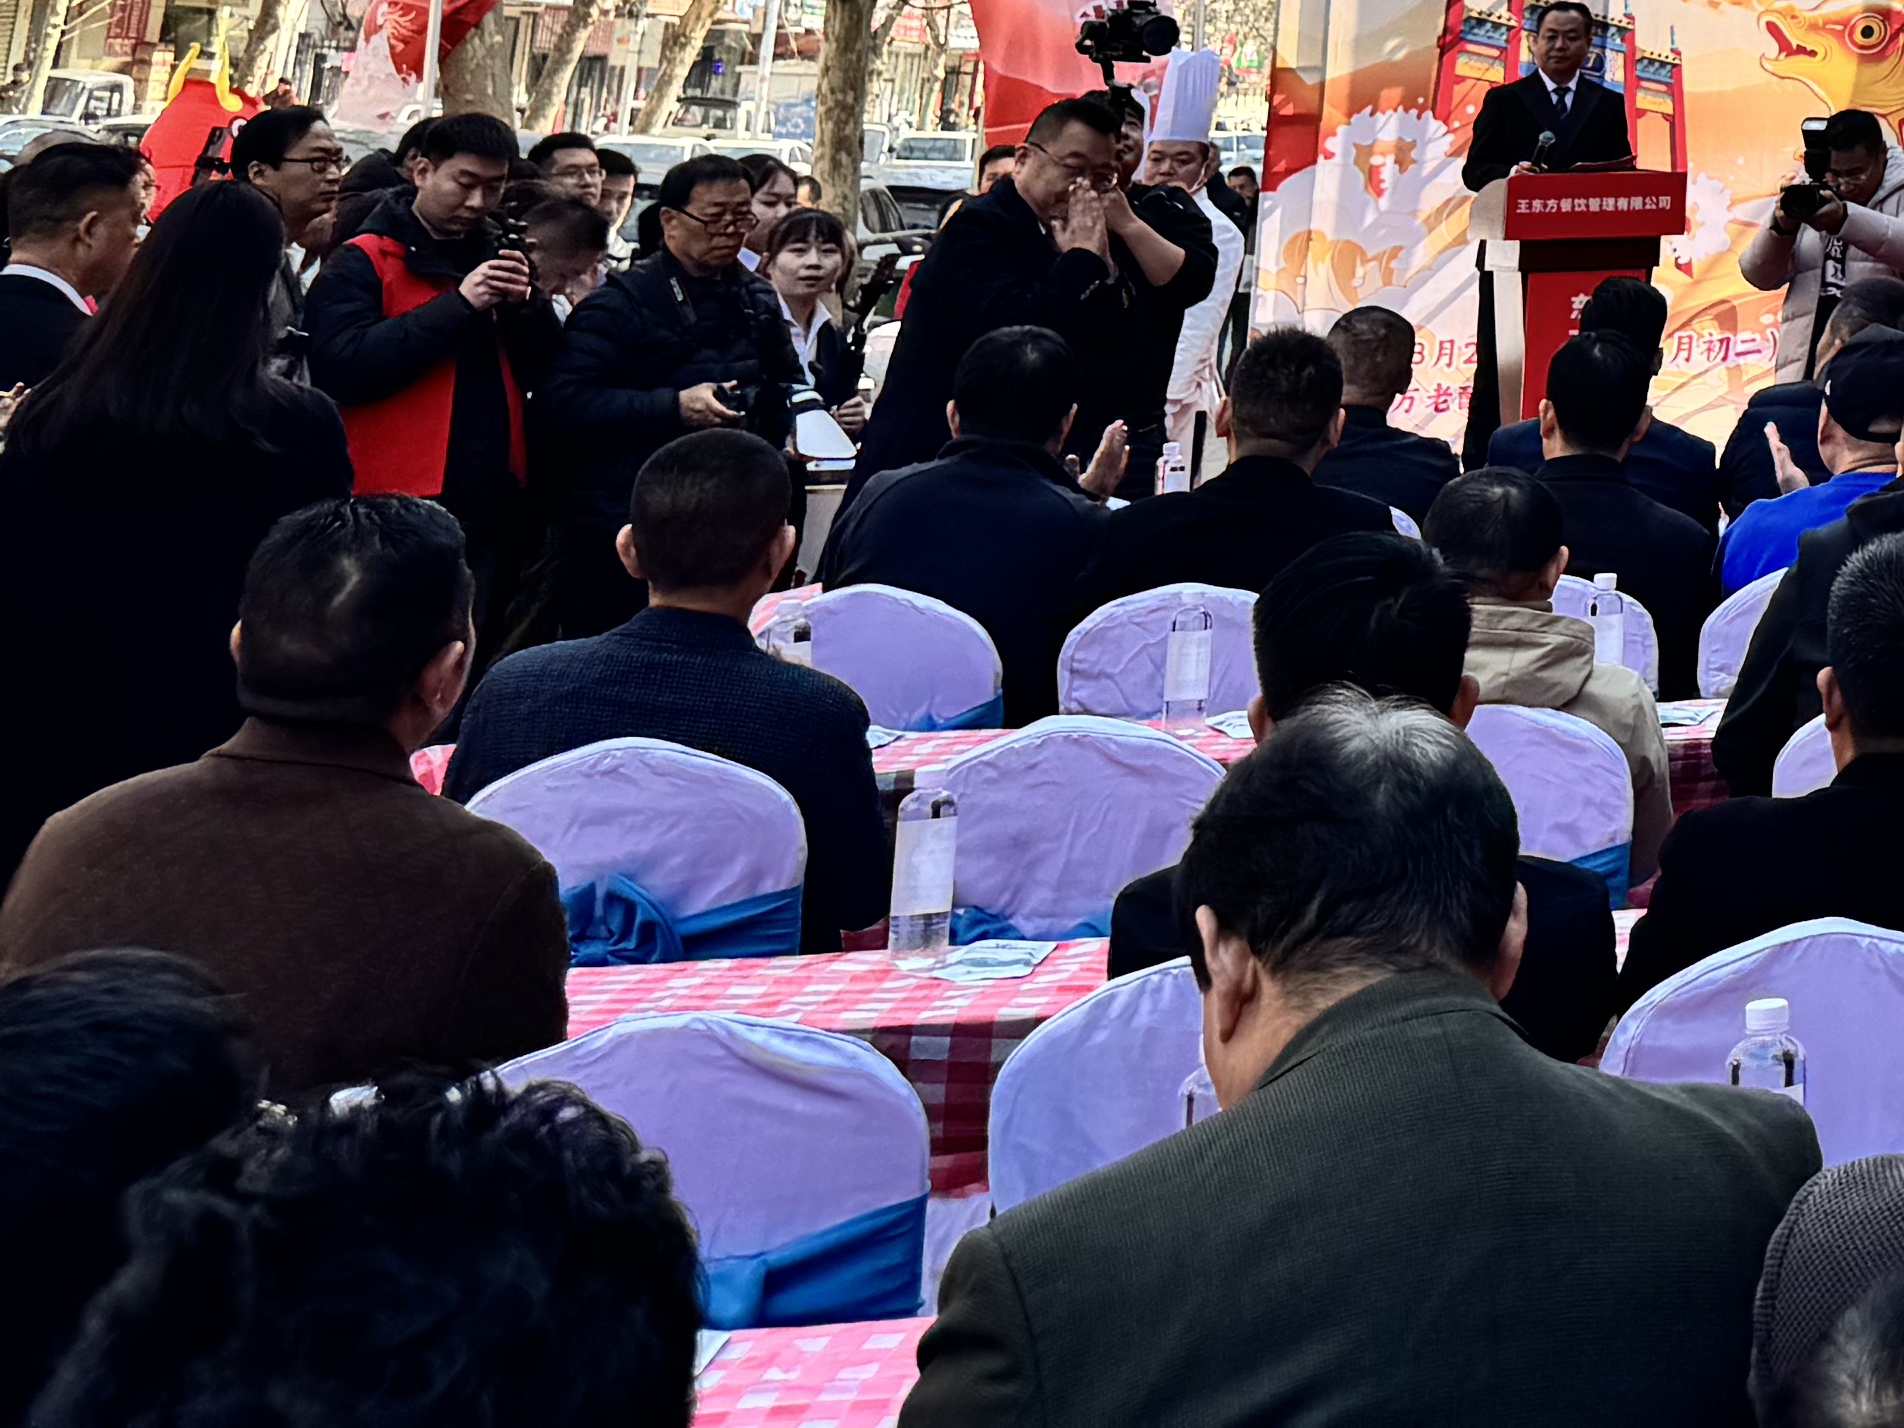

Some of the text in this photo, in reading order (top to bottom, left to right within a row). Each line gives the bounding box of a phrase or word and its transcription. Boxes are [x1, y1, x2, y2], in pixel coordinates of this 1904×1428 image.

[1516, 194, 1672, 215] 王东方餐饮管理有限公司
